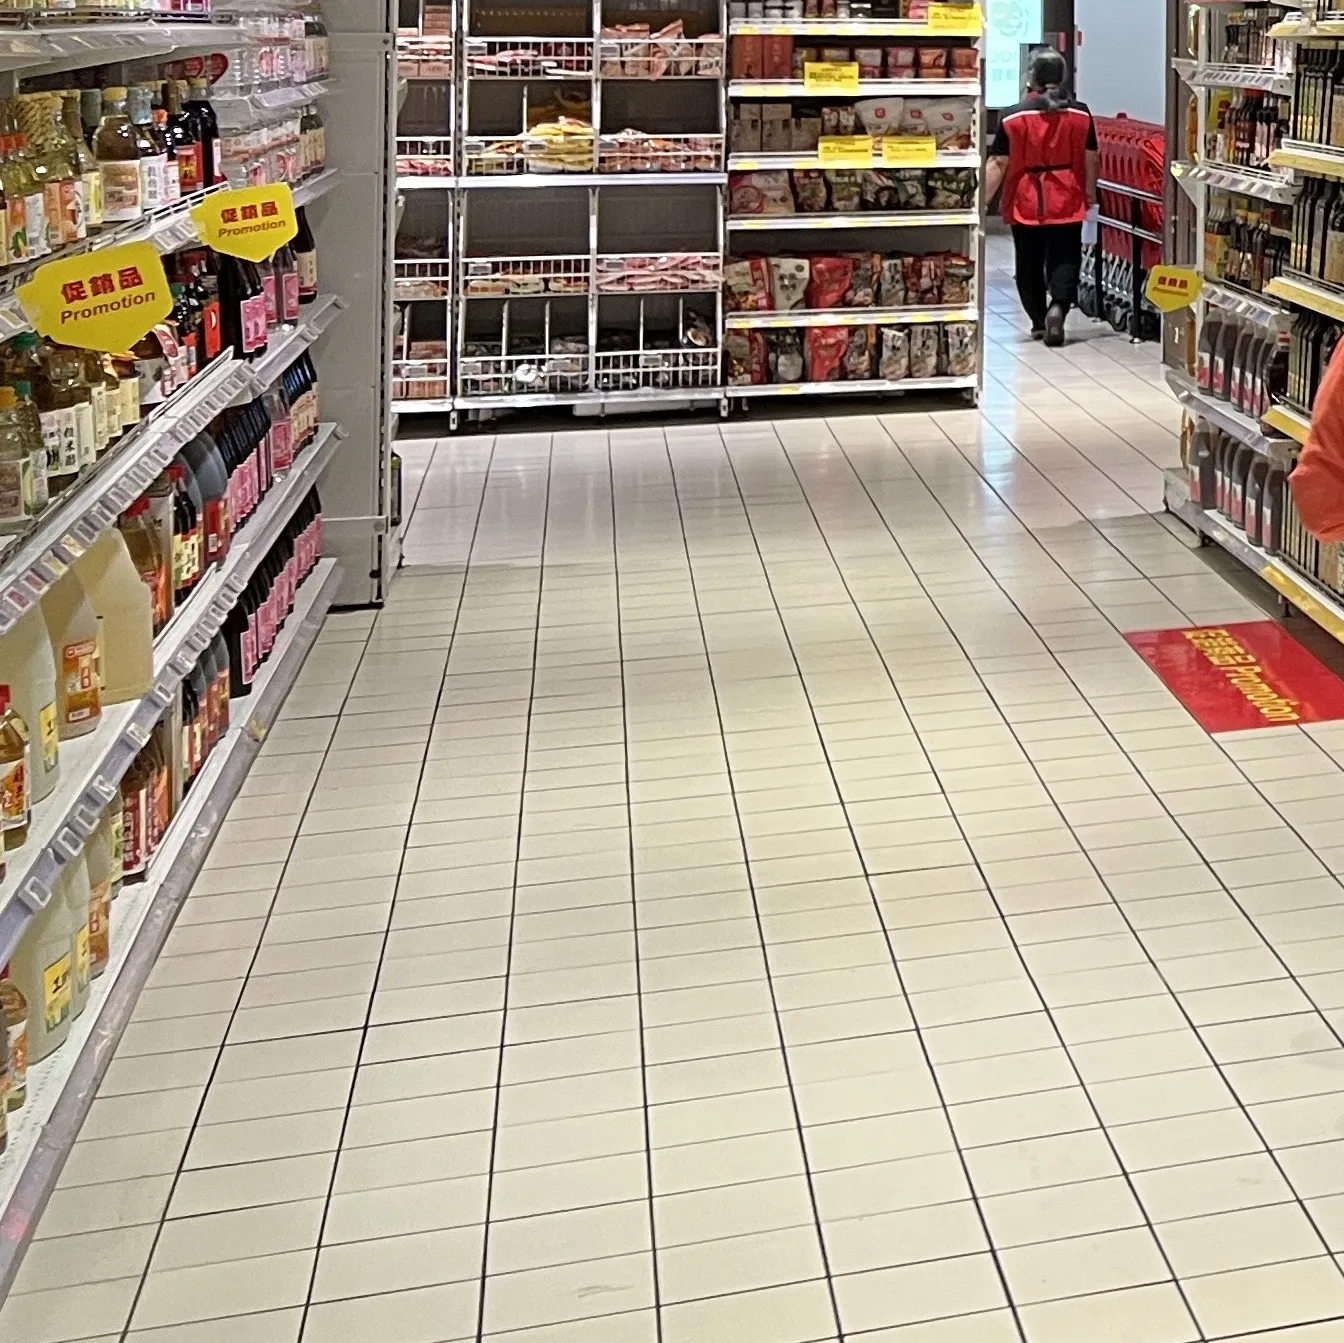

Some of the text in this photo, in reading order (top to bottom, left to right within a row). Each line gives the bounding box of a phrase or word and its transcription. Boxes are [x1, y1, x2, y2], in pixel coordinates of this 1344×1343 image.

[218, 219, 286, 240] Promotion
[220, 201, 279, 224] 促銷品
[61, 266, 143, 304] 促銷品
[60, 289, 156, 325] Promotion
[1220, 666, 1299, 721] Promotion
